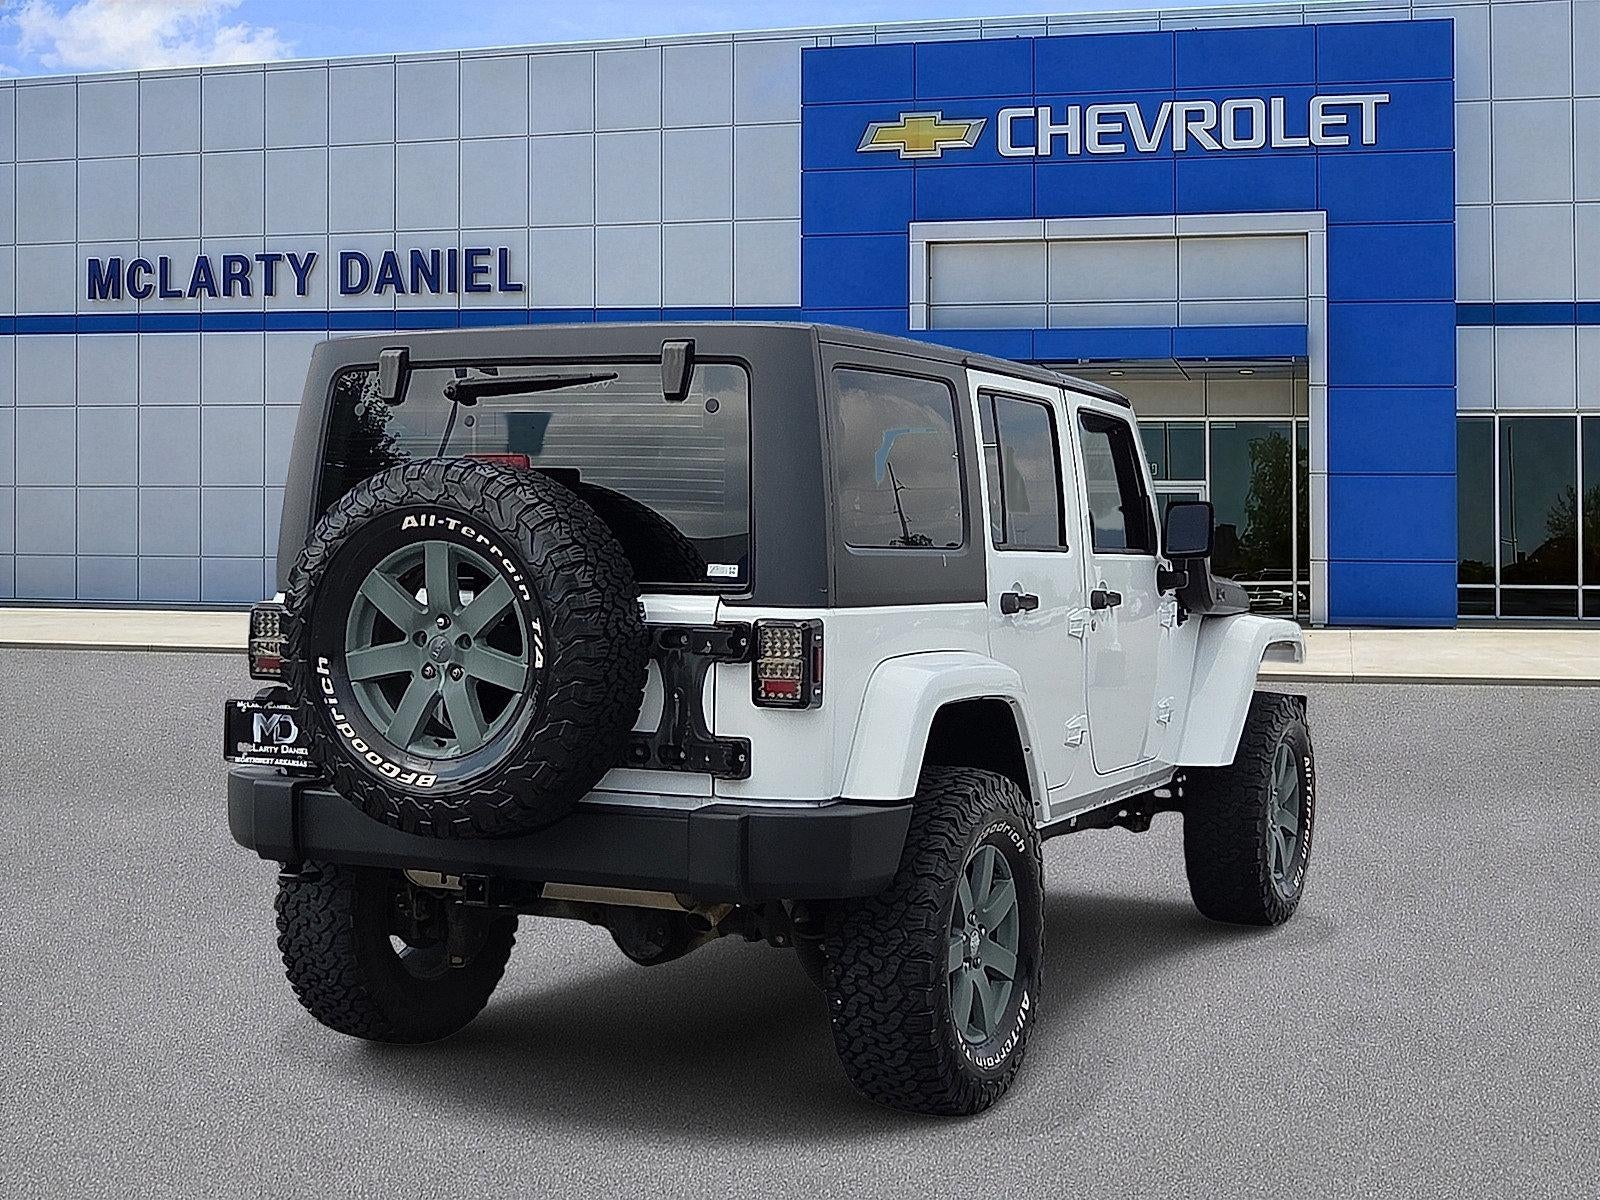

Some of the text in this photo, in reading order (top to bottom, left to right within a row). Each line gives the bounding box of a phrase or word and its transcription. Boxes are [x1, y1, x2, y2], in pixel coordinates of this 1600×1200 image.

[997, 93, 1390, 158] CHEVROLET
[86, 246, 525, 301] MCLARTY DANIEL
[401, 514, 530, 601] All-Terrain
[316, 656, 438, 788] BFGoodrich
